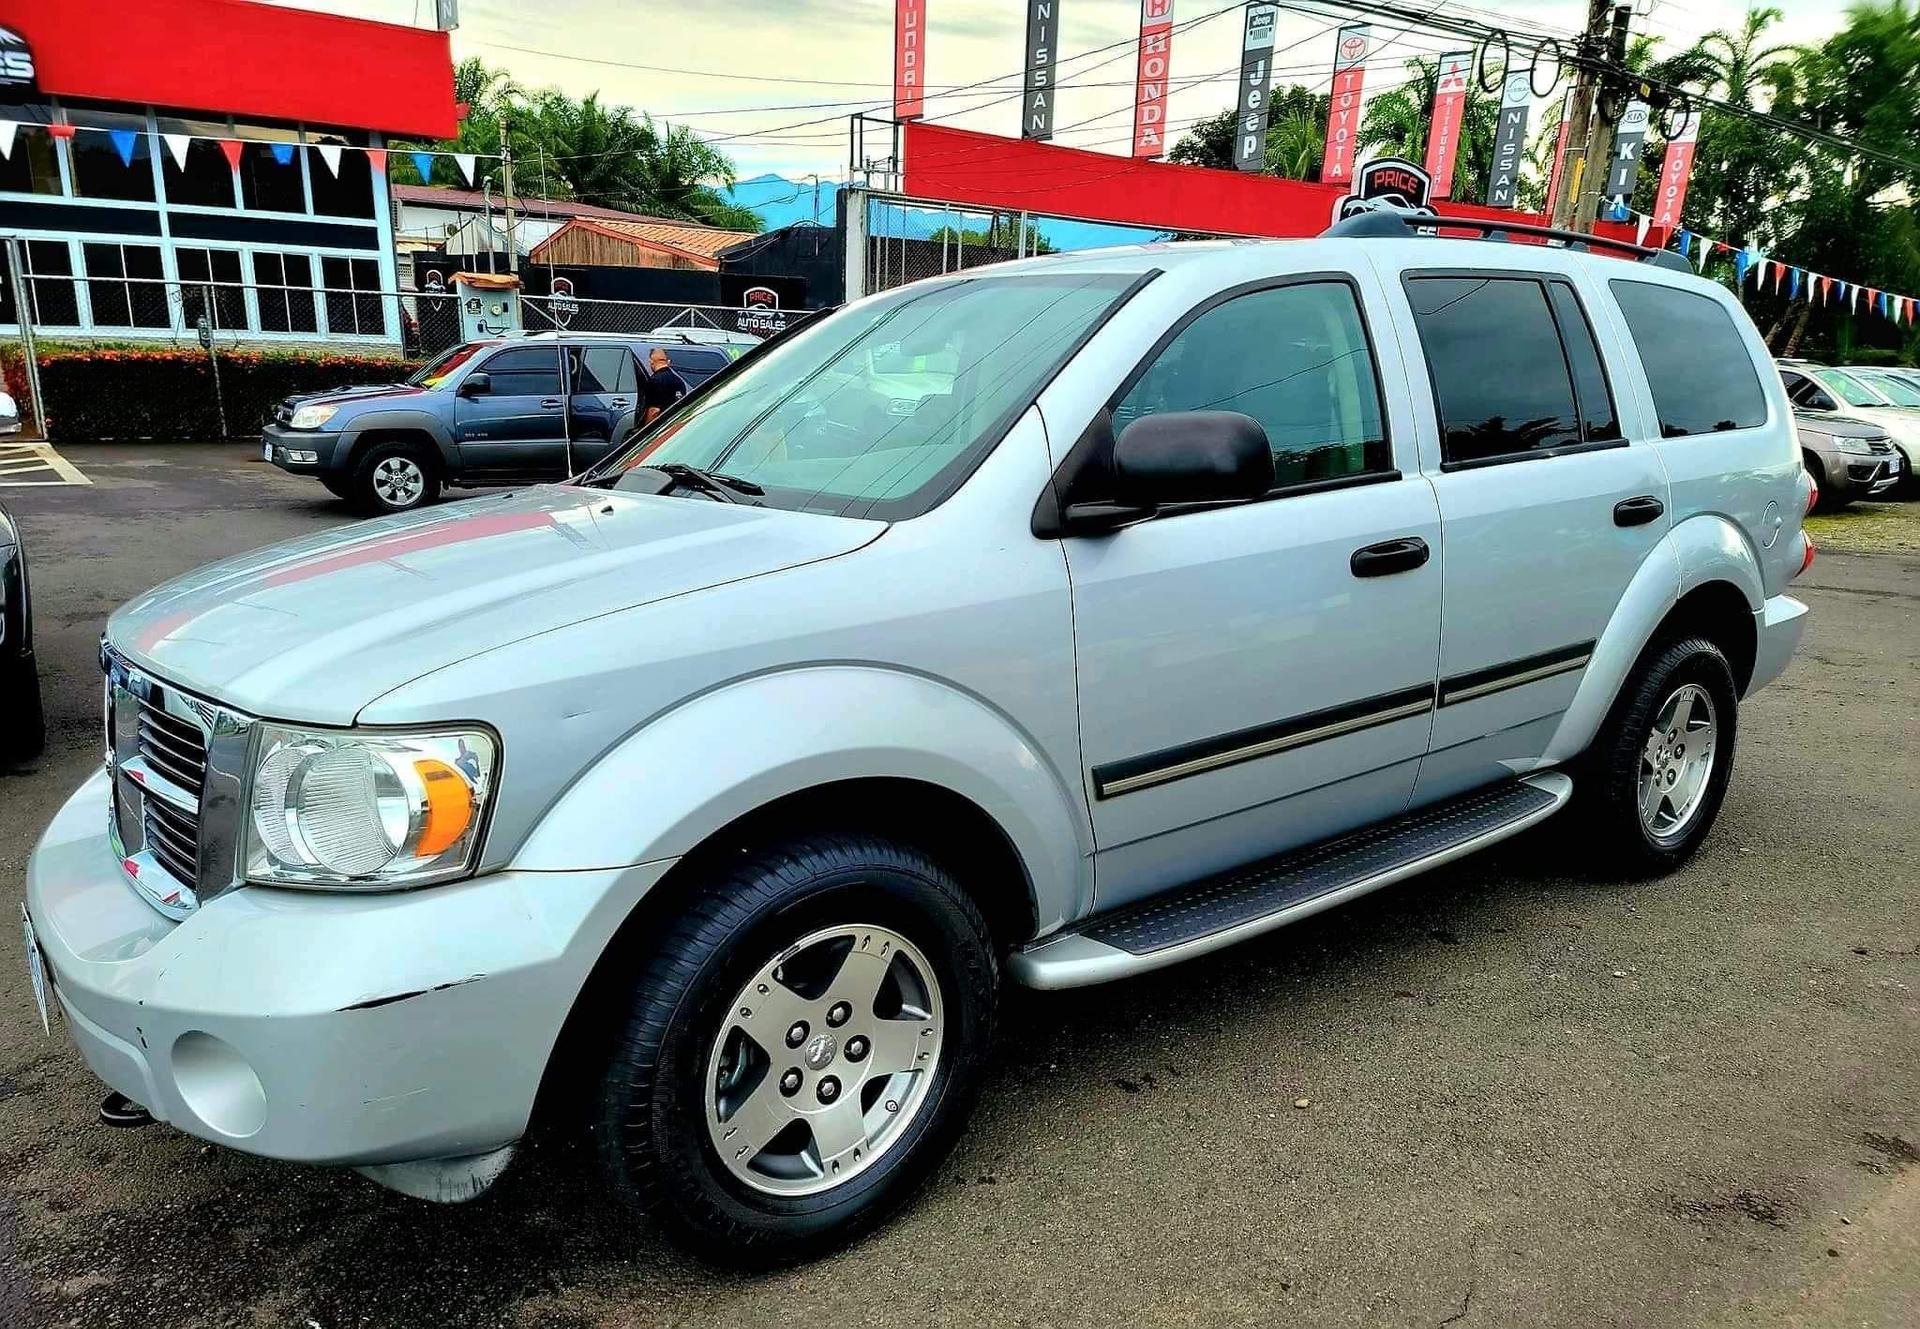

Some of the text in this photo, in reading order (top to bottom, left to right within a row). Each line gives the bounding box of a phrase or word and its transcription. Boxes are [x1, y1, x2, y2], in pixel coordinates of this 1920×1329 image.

[1032, 2, 1051, 130] NISSAN
[1139, 31, 1168, 148] HONDA
[1242, 59, 1265, 159] Jeep
[1330, 73, 1355, 178] TOYOTA
[1434, 97, 1454, 190] MITSUBISHI
[1626, 112, 1643, 121] KIA
[1374, 170, 1418, 194] PRICE
[1494, 111, 1521, 201] NISSAN
[1608, 142, 1636, 211] KIA
[1661, 146, 1686, 223] TOYOTA
[737, 317, 759, 328] AUTO
[760, 319, 786, 331] SALES
[749, 291, 773, 303] PRICE
